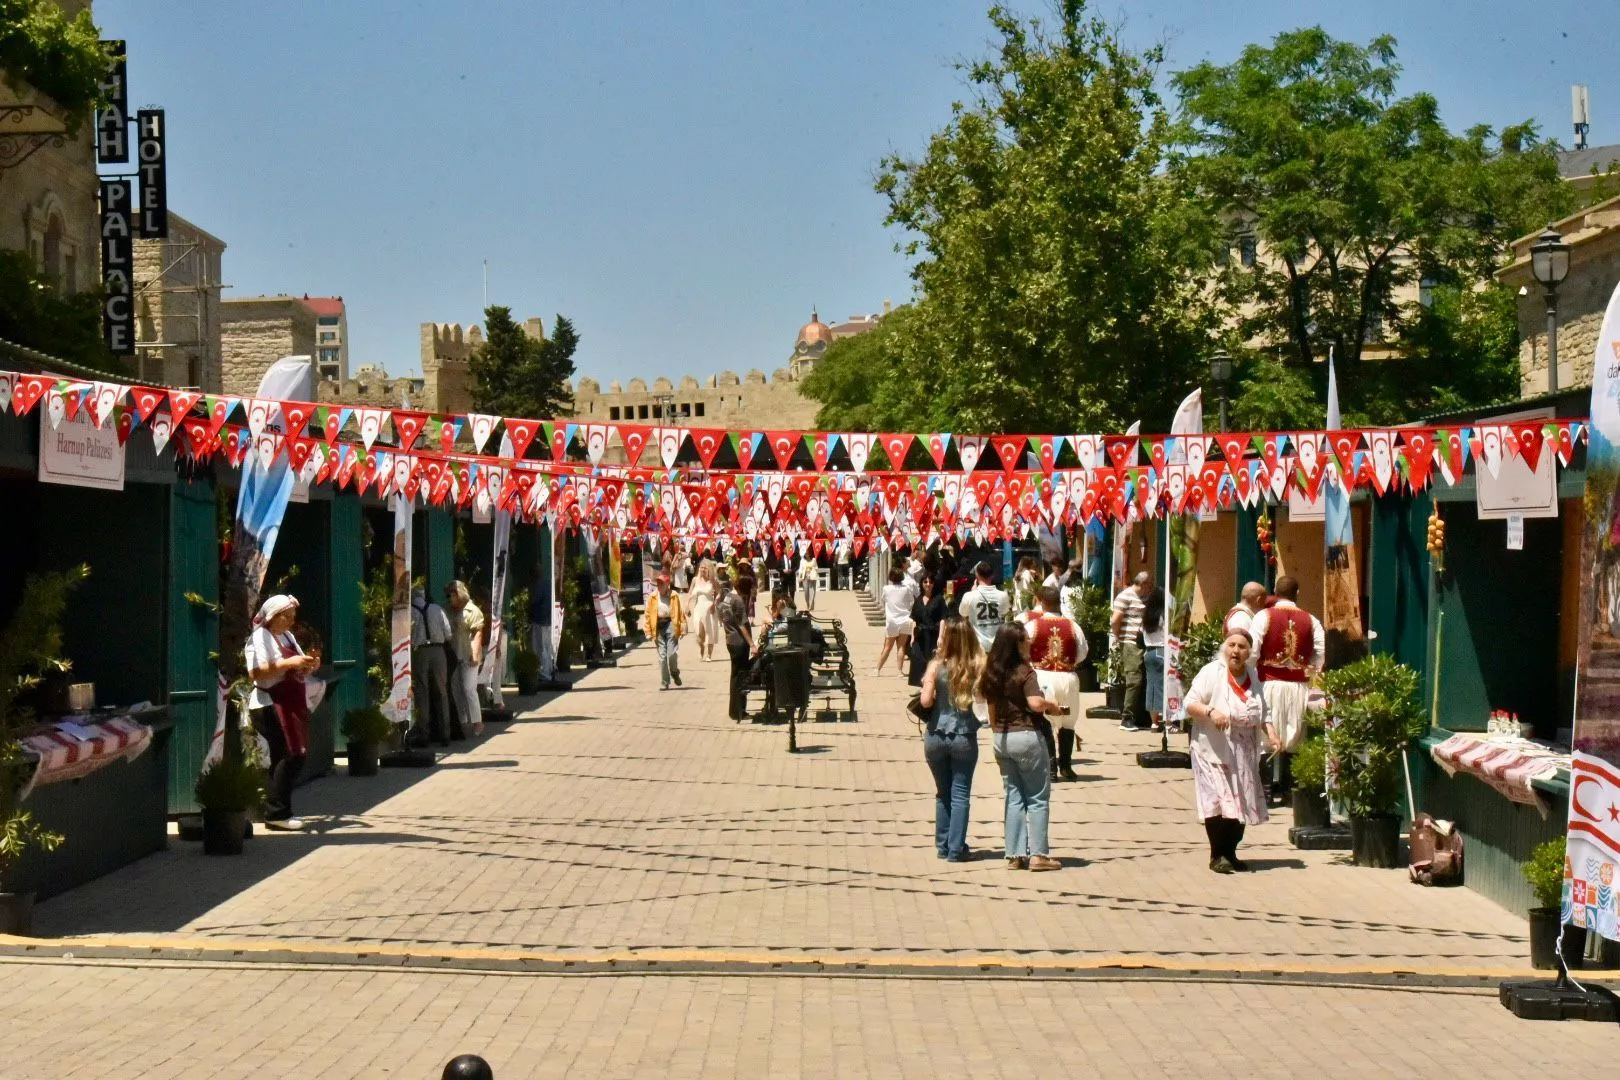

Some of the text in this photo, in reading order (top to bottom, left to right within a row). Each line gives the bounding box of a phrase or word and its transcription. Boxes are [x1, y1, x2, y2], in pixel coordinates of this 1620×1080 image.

[98, 45, 128, 350] HAH PALACE
[140, 115, 161, 232] HOTEL
[976, 602, 999, 620] 26
